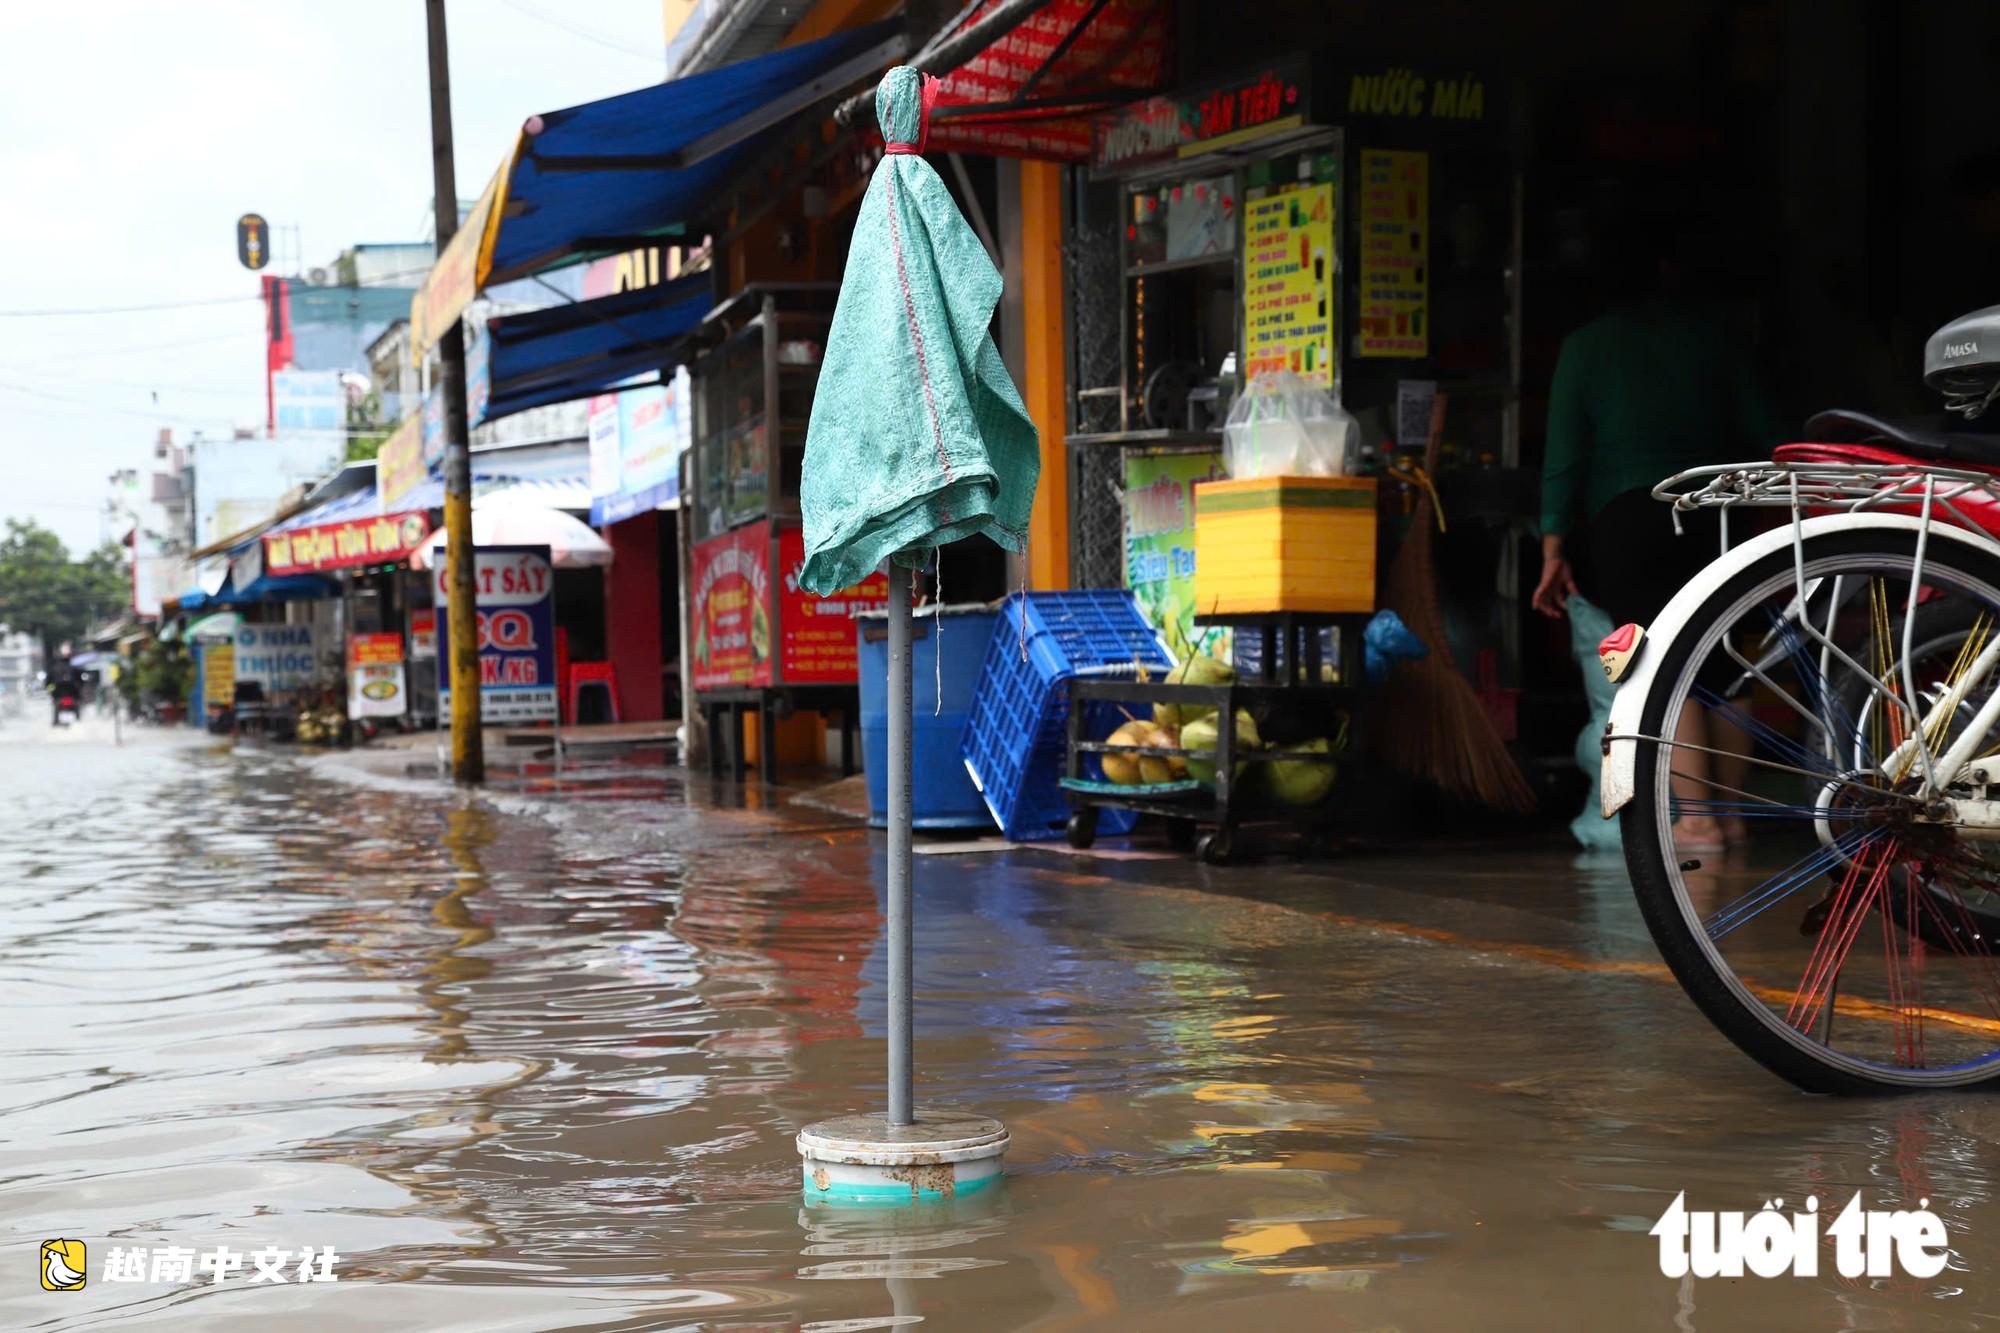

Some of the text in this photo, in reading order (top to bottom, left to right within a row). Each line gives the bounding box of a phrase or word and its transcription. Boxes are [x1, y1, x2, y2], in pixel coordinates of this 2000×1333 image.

[1349, 68, 1485, 119] NƯỚC MÍA
[1944, 342, 1978, 359] AMASA
[502, 555, 547, 594] SẤY
